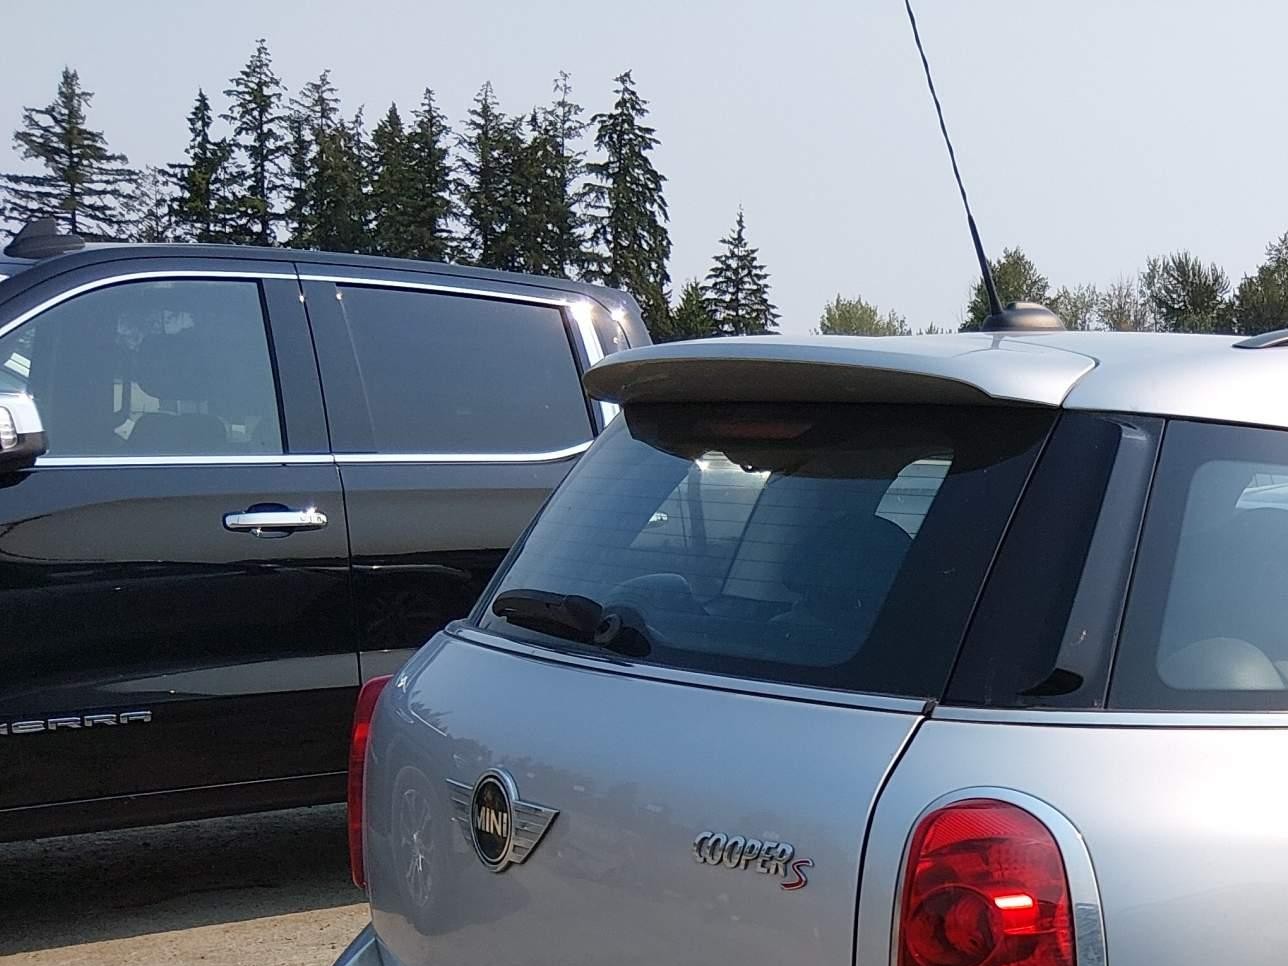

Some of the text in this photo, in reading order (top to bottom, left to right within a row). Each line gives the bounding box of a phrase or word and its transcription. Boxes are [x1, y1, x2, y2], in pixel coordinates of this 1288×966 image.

[475, 806, 508, 838] MINI
[694, 831, 814, 890] COOPER S
